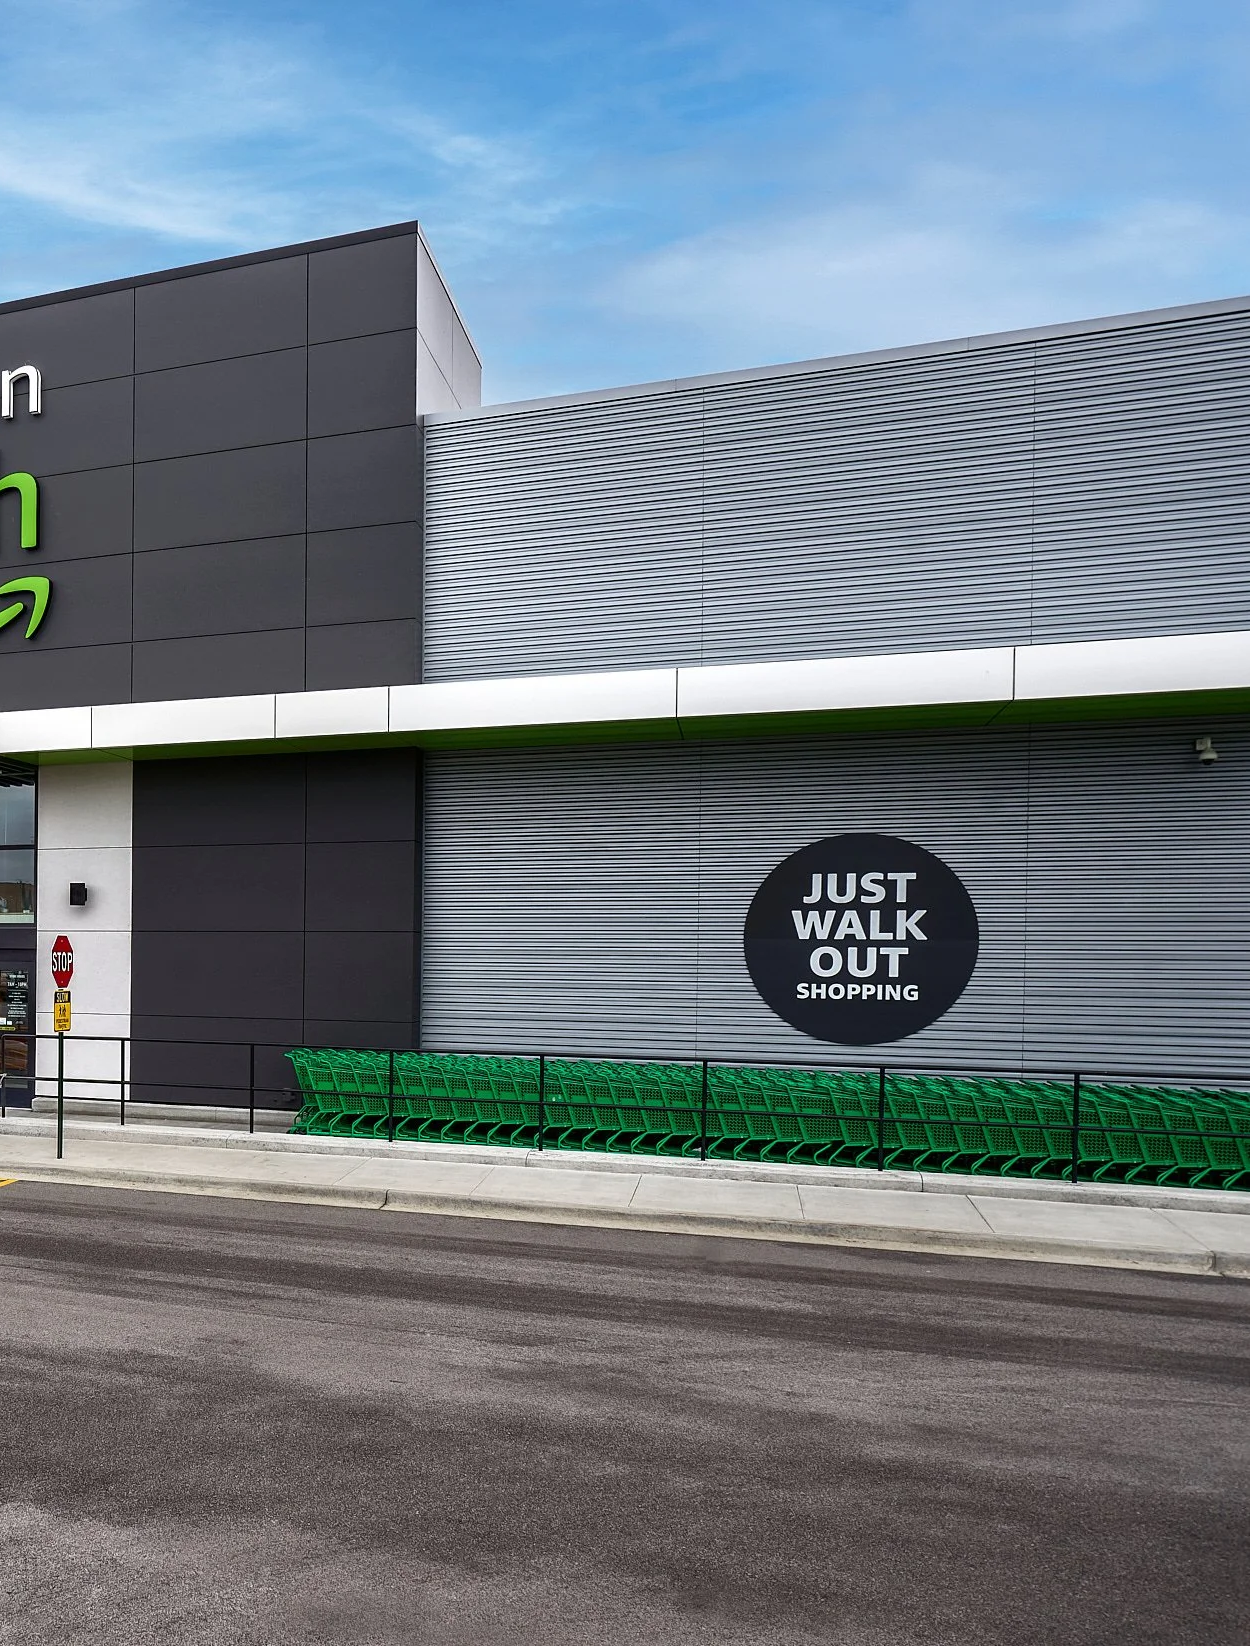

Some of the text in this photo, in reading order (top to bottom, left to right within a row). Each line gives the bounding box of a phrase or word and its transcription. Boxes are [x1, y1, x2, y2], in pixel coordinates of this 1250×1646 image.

[803, 872, 917, 904] JUST
[791, 909, 928, 941] WALK
[52, 951, 73, 972] STOP
[809, 946, 909, 978] OUT
[796, 983, 919, 1001] SHOPPING
